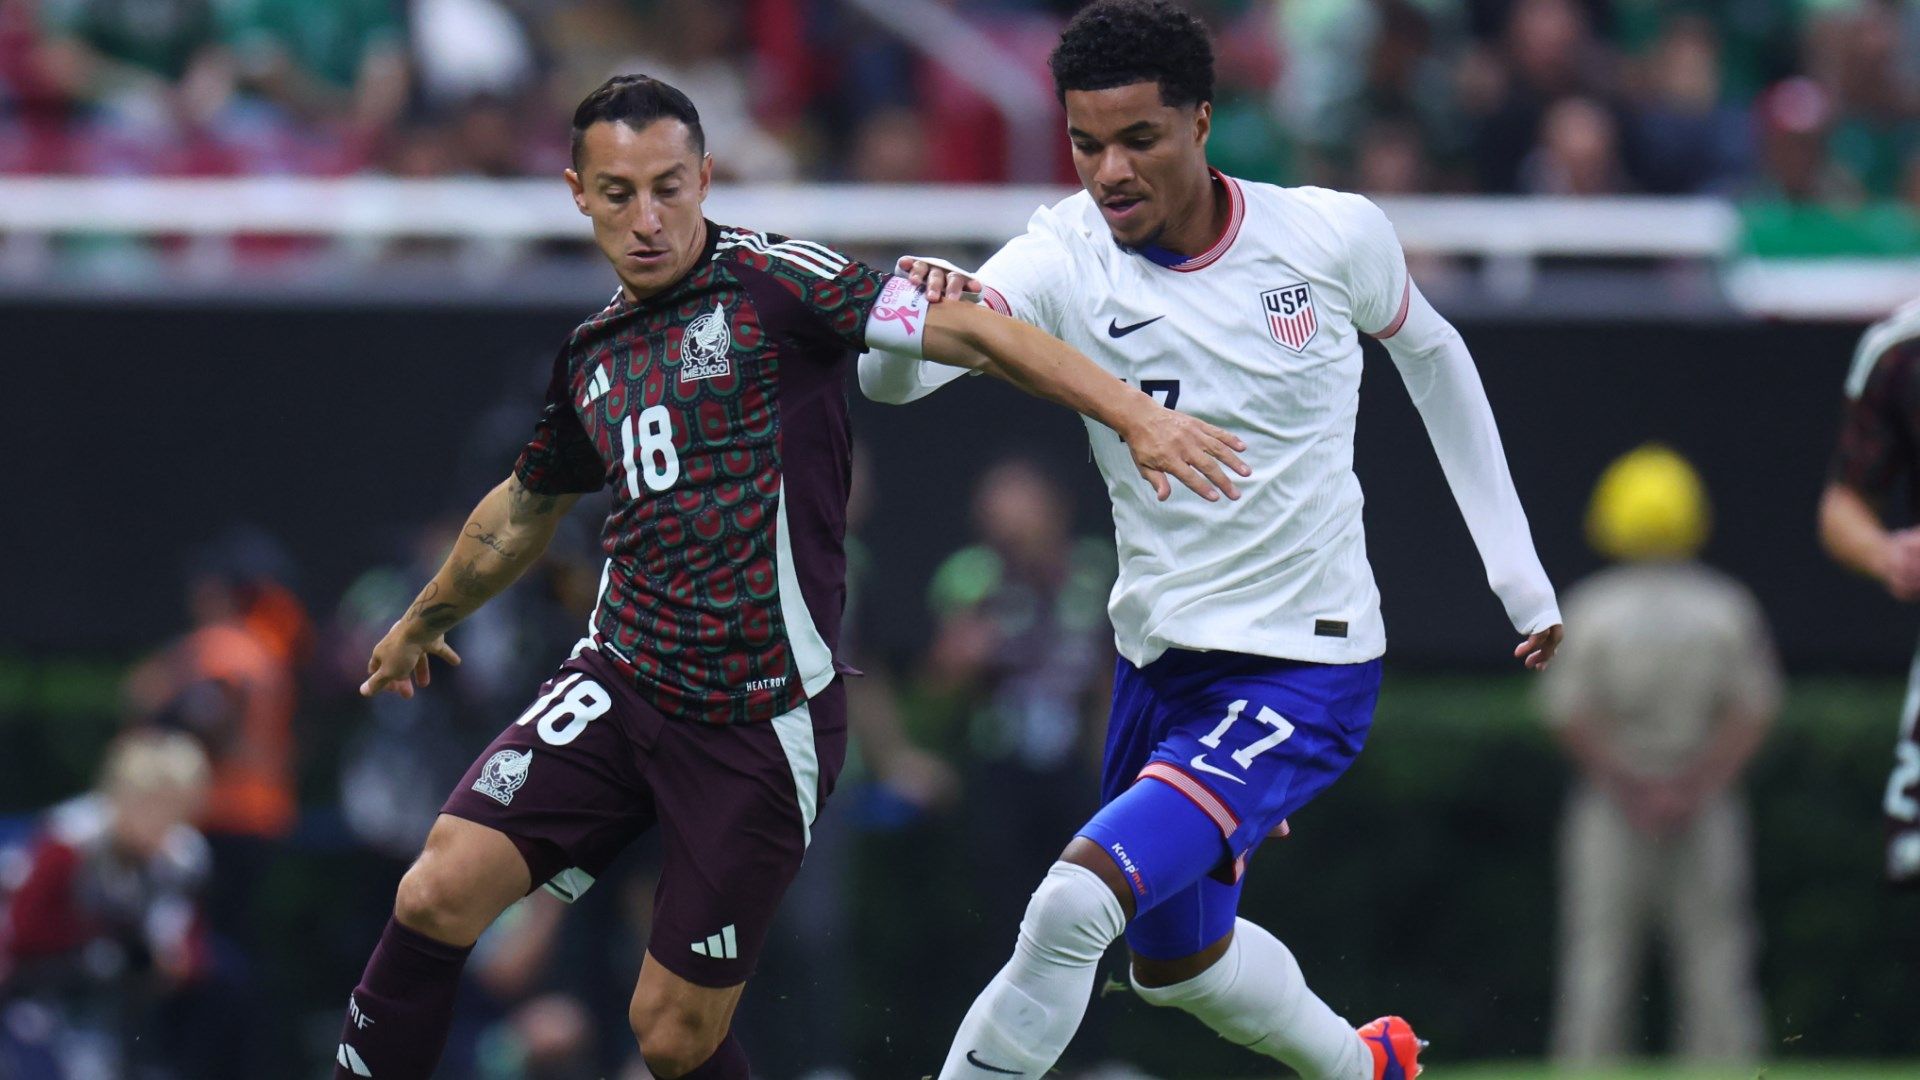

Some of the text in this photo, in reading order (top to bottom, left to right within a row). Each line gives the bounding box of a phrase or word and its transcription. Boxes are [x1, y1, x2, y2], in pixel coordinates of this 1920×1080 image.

[1265, 287, 1308, 315] USA
[683, 363, 727, 380] MÉXICO
[621, 404, 680, 500] 18
[515, 672, 612, 746] 18
[1198, 699, 1296, 770] 17
